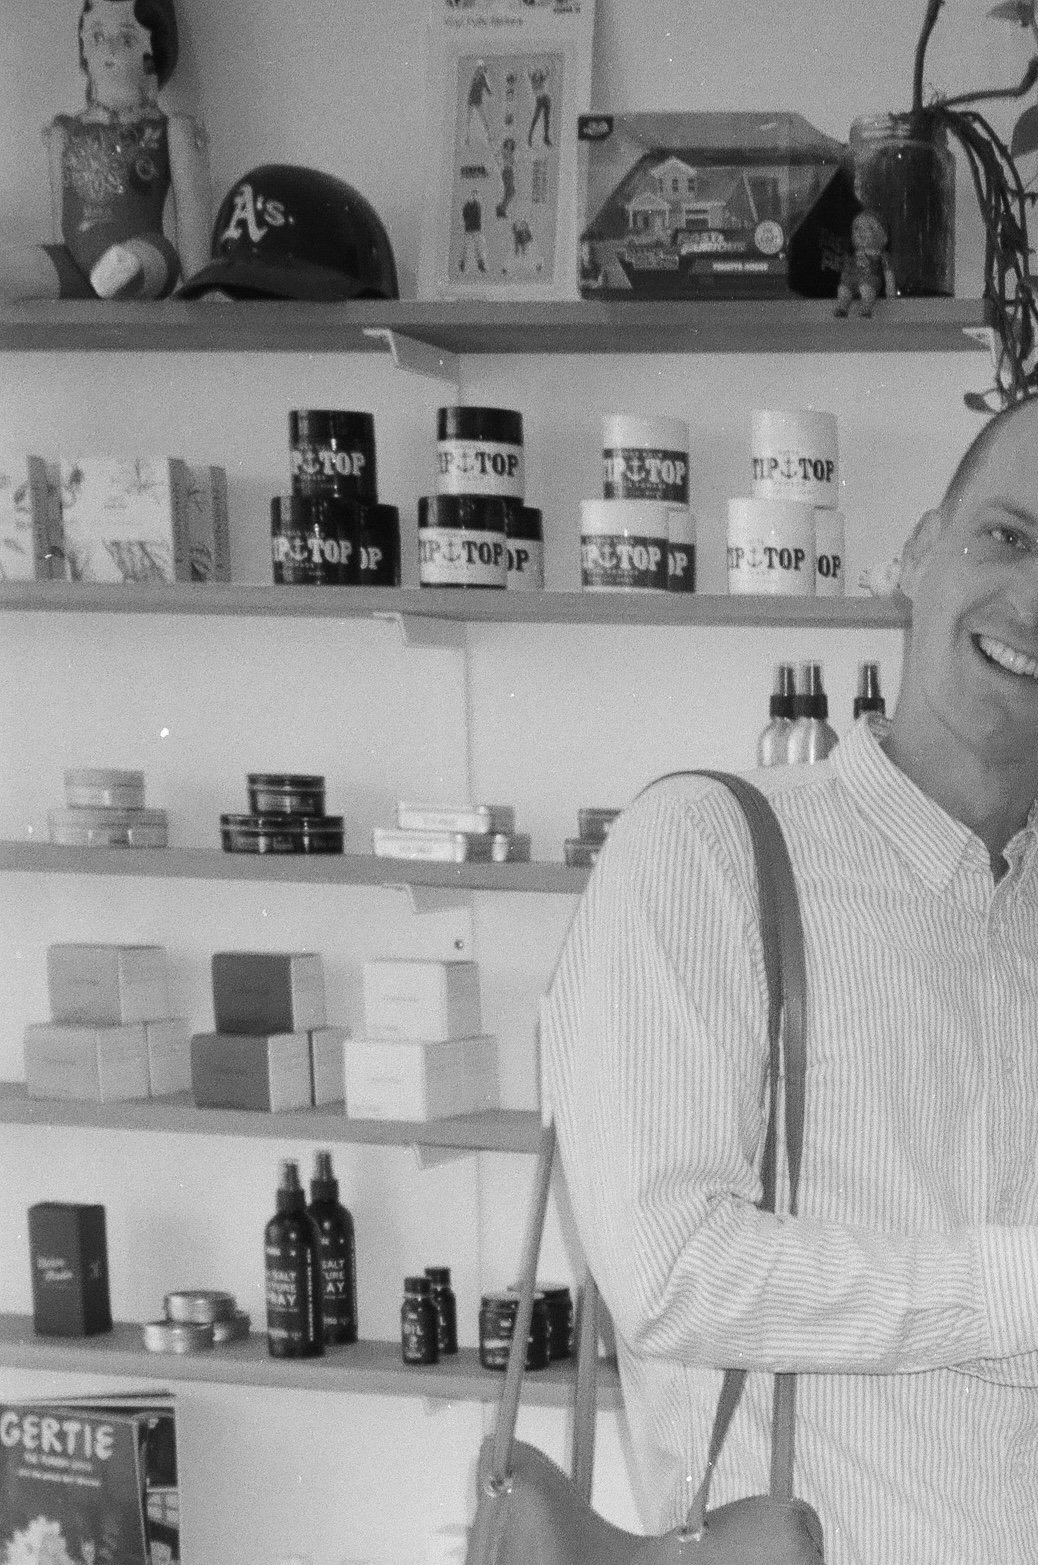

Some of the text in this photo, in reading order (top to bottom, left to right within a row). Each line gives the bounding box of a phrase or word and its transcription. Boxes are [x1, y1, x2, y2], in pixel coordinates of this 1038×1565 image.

[318, 450, 366, 476] TOP
[475, 452, 519, 477] TOP
[645, 459, 686, 485] TOP
[798, 458, 835, 482] TOP
[307, 538, 352, 564] TOP
[462, 541, 507, 566] TOP
[616, 545, 661, 571] TOP
[763, 547, 805, 571] TOP
[0, 1411, 114, 1460] GERTIE
